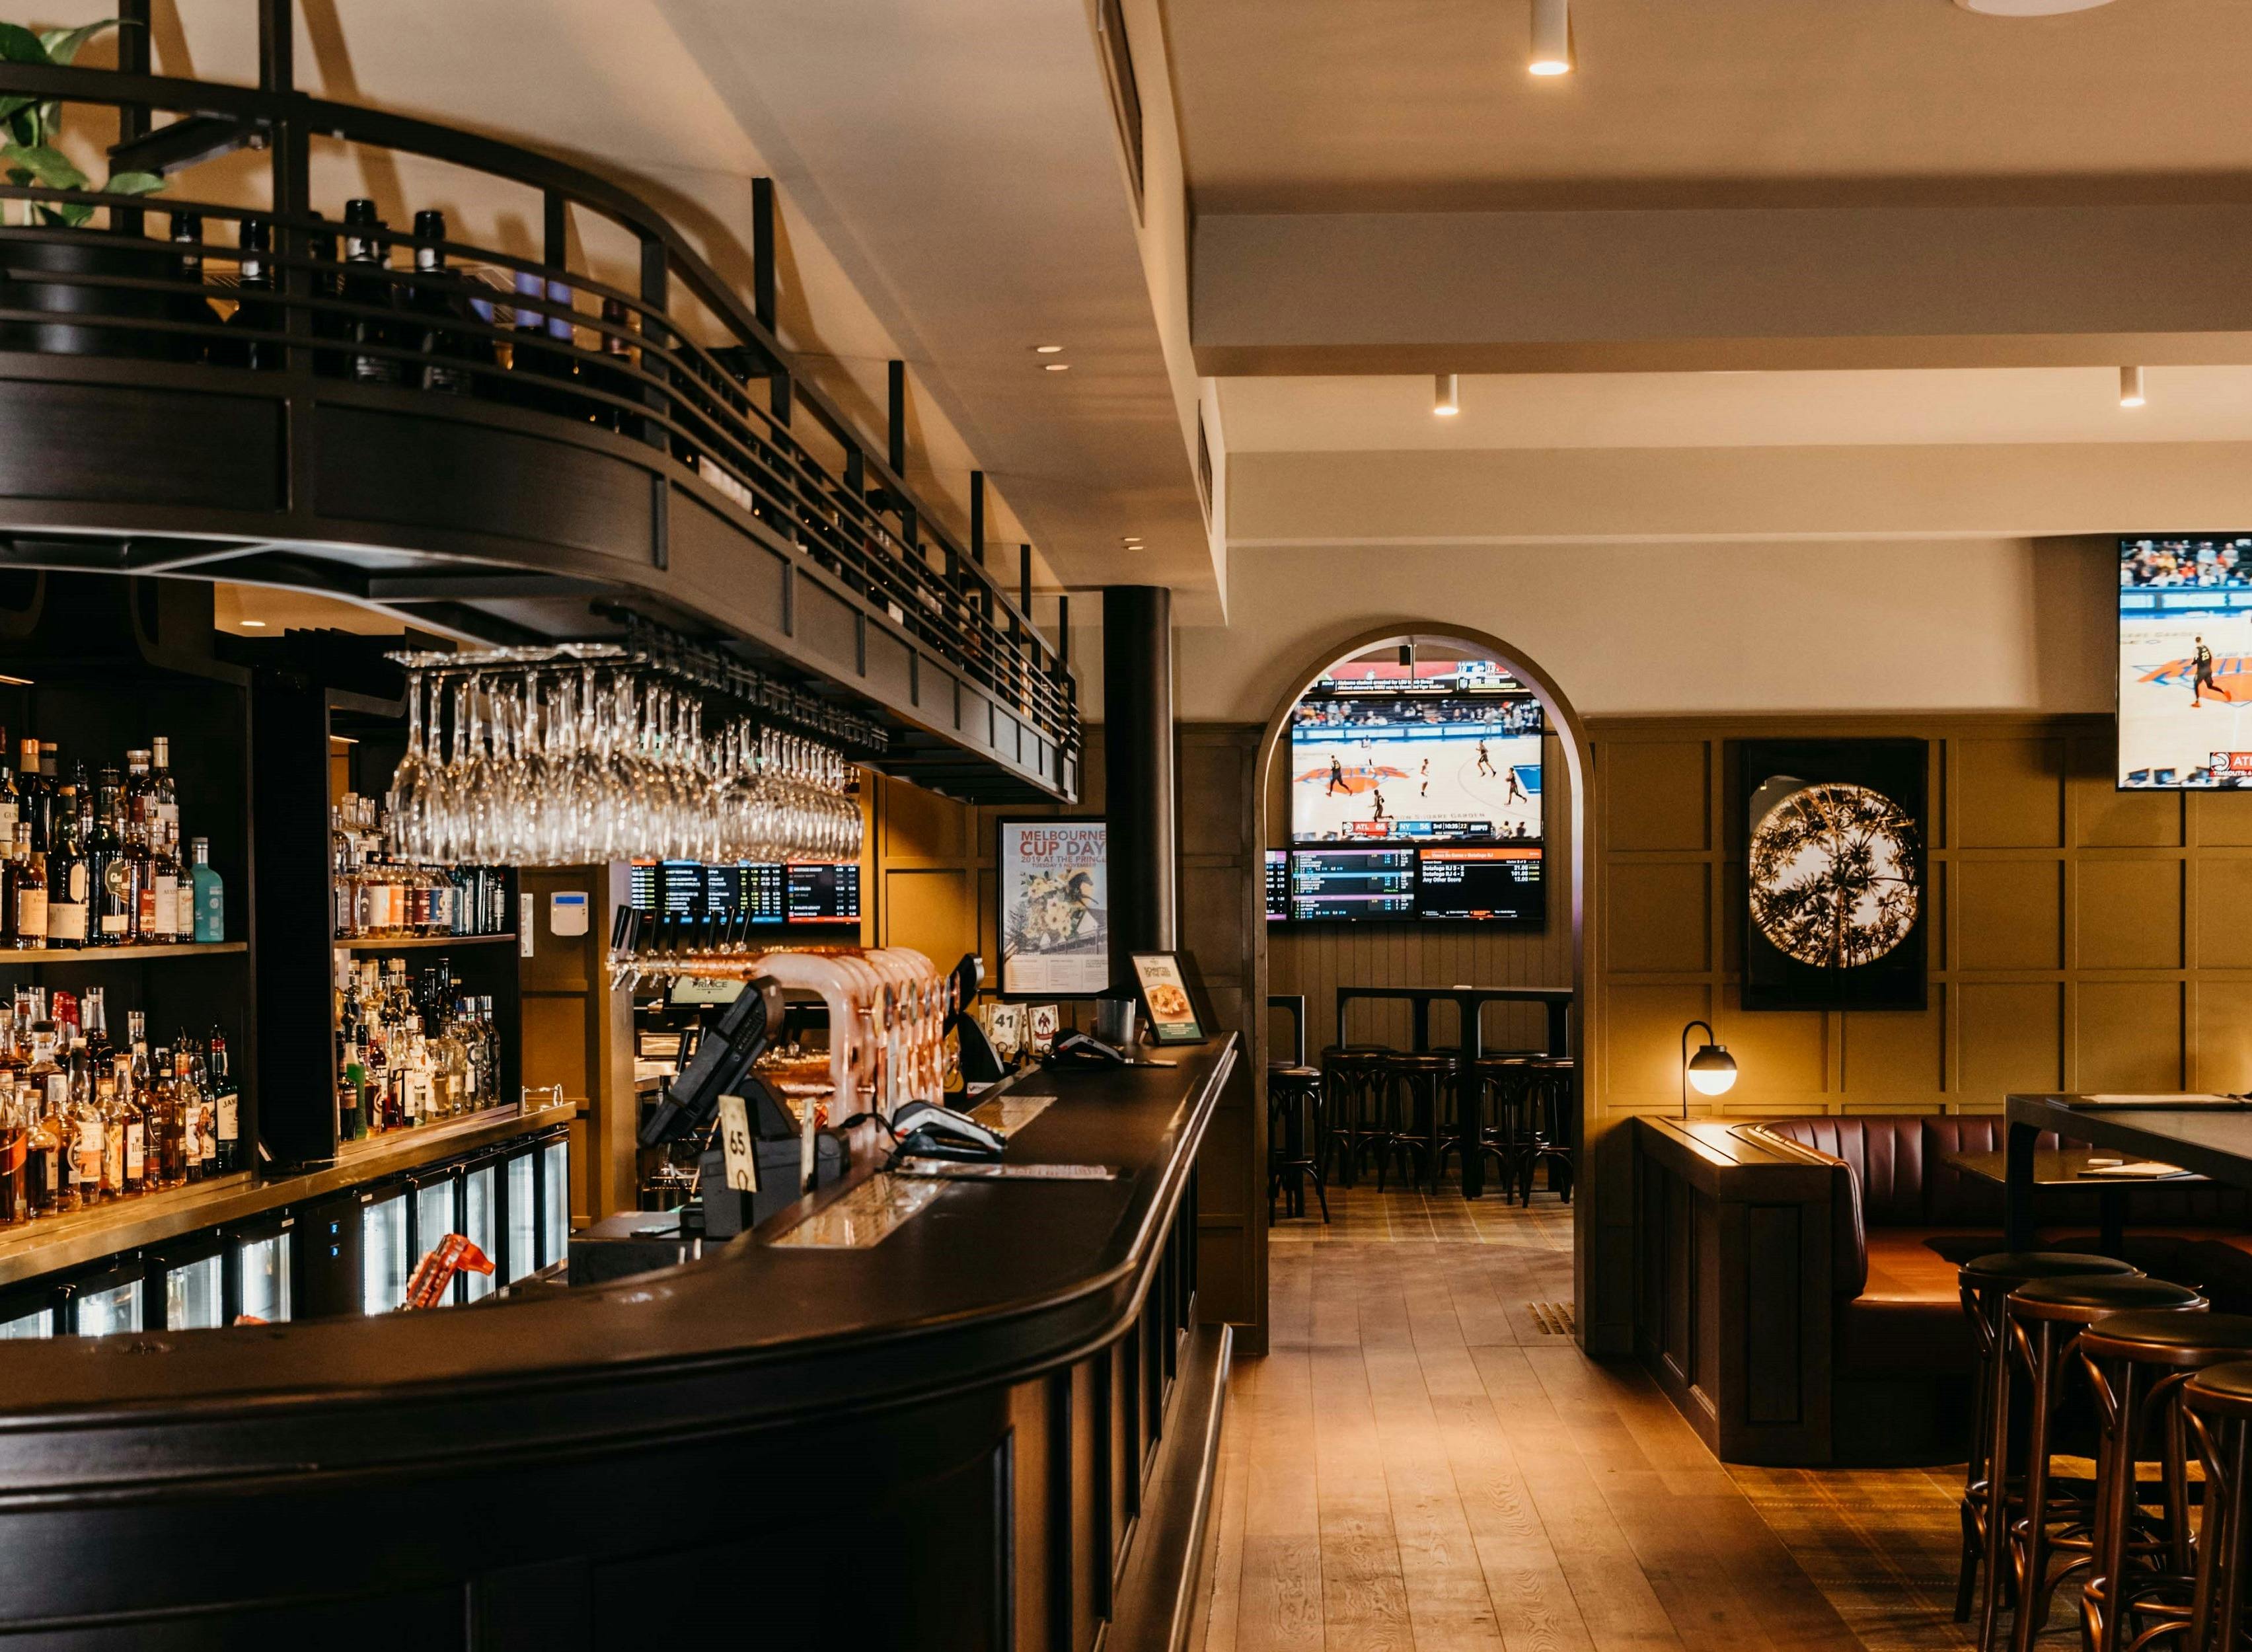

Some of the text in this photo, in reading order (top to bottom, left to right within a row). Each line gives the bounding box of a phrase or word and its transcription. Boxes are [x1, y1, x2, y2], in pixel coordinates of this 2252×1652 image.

[1022, 831, 1106, 841] MELBOURNE
[1020, 841, 1106, 856] CUP DAY
[995, 1014, 1014, 1028] 41
[730, 1130, 745, 1156] 65
